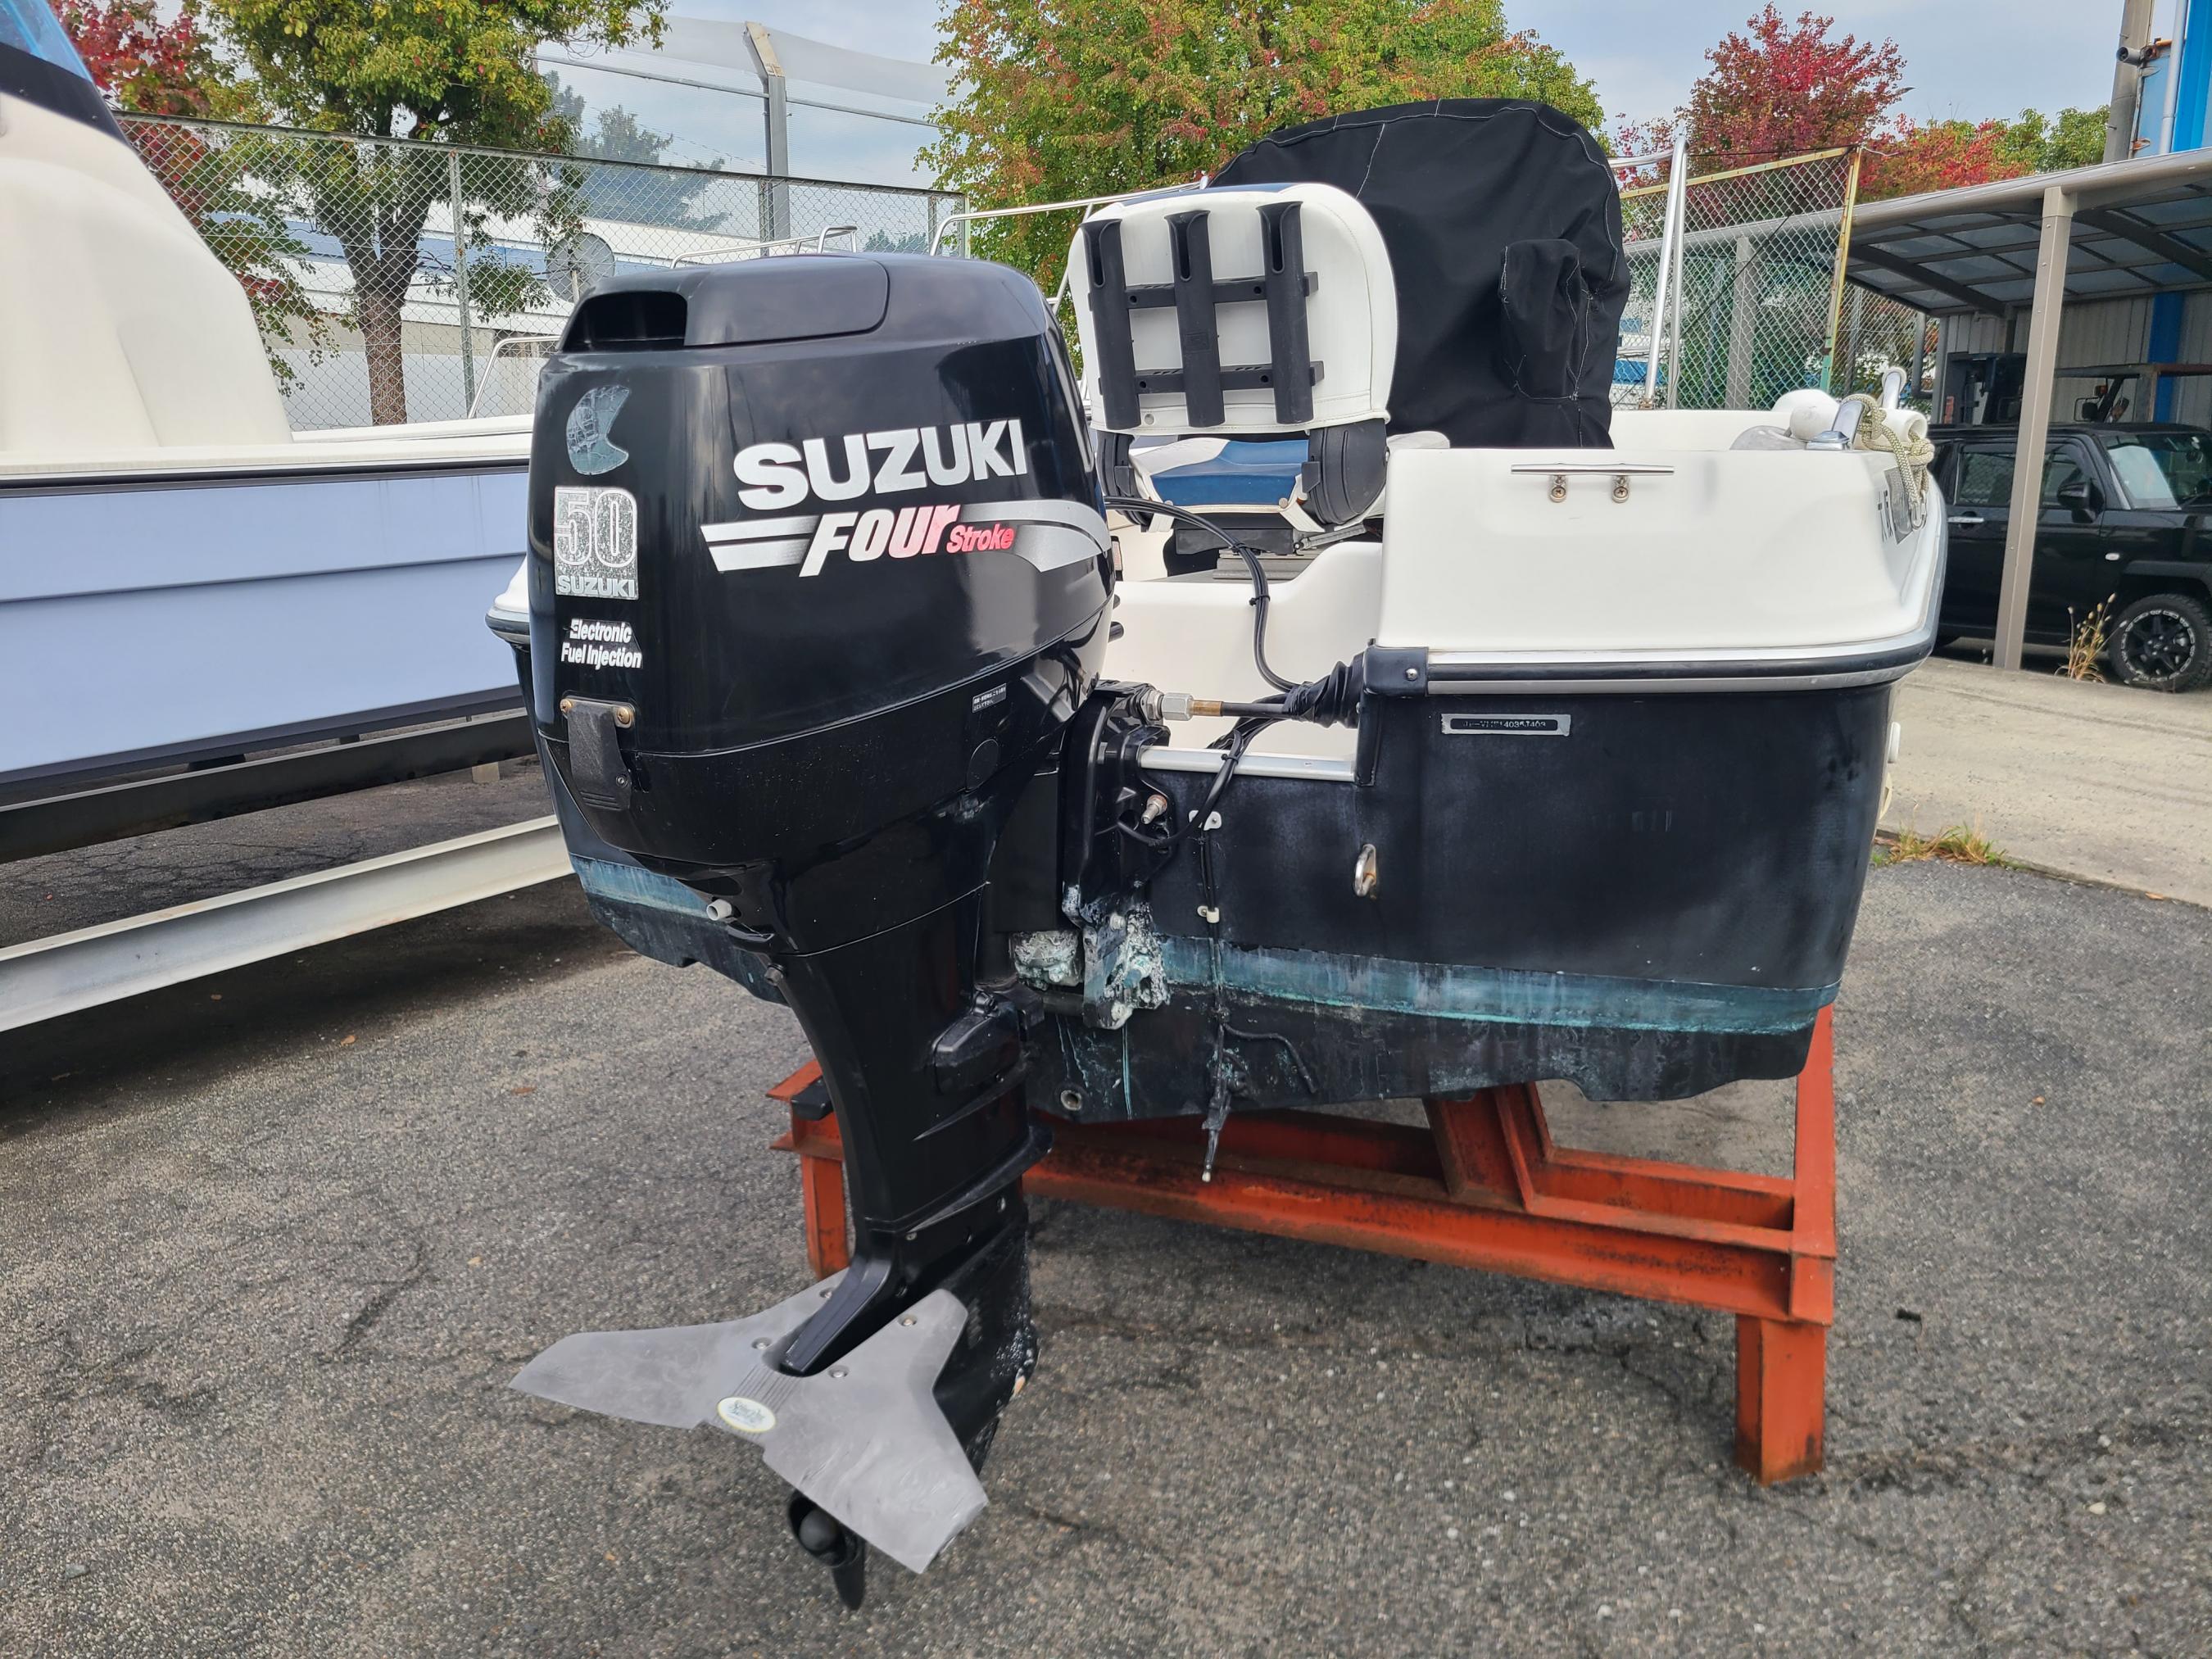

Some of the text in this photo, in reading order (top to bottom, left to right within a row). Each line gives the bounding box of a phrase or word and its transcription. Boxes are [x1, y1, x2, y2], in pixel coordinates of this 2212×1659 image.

[734, 419, 1027, 510] SUZUKI
[555, 490, 637, 568] 50
[945, 524, 1015, 554] Stroke
[558, 575, 635, 597] SUZUKI
[569, 619, 632, 643] Electronic
[560, 641, 642, 670] Fuel Injection
